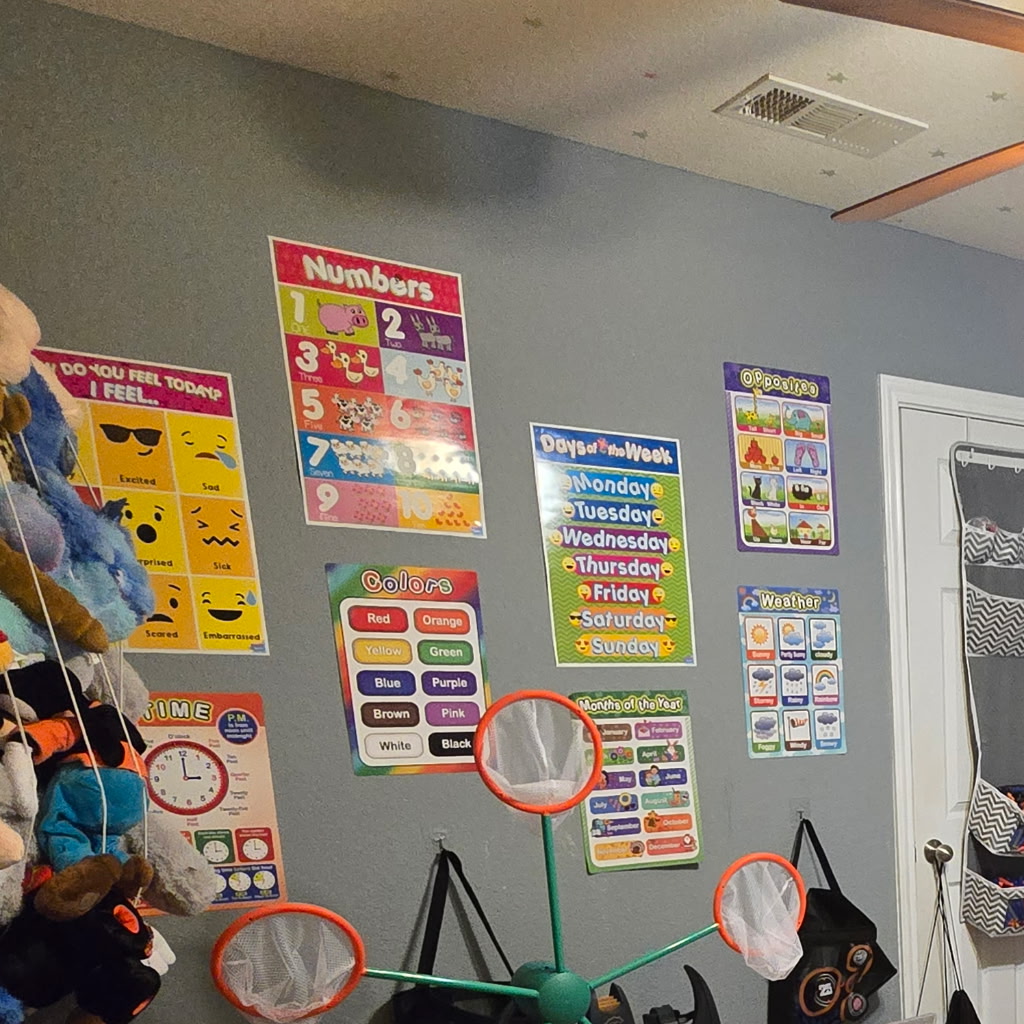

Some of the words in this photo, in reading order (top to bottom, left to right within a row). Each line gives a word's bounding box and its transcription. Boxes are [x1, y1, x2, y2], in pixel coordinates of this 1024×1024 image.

[302, 254, 434, 302] Numbers
[290, 291, 305, 323] 1
[381, 308, 405, 339] 2
[295, 341, 319, 373] 3
[60, 362, 88, 376] DO
[88, 363, 124, 380] YOU
[129, 369, 162, 387] FEEL
[386, 354, 408, 385] 4
[90, 380, 97, 398] I
[301, 388, 325, 420] 5
[390, 399, 412, 429] 6
[306, 435, 330, 466] 7
[395, 443, 417, 474] 8
[540, 434, 586, 459] Days
[586, 442, 598, 454] of
[607, 443, 626, 457] the
[625, 441, 673, 465] Week
[119, 474, 156, 486] Excited
[202, 482, 220, 491] Sad
[572, 472, 650, 500] Monday
[316, 483, 339, 512] 9
[399, 490, 434, 520] 10
[575, 500, 652, 527] Tuesday
[562, 526, 668, 555] Wednesday
[213, 561, 231, 570] Sick
[576, 556, 660, 580] Thursday
[361, 569, 453, 594] Colors
[593, 585, 649, 606] Friday
[761, 593, 820, 610] Weather
[367, 613, 391, 624] Red
[422, 615, 463, 628] Orange
[581, 610, 666, 632] Saturday
[145, 630, 179, 638] Scared
[203, 631, 260, 641] Embarrassed
[365, 646, 402, 656] Yellow
[429, 647, 463, 657] Green
[591, 638, 660, 657] Sunday
[375, 678, 401, 688] Blue
[432, 678, 468, 690] Purple
[373, 709, 410, 719] Brown
[441, 708, 466, 718] Pink
[579, 698, 621, 711] Months
[624, 698, 635, 710] of
[638, 698, 655, 711] the
[658, 697, 681, 710] Year
[379, 740, 411, 751] White
[441, 739, 472, 749] Black
[155, 763, 166, 771] 10
